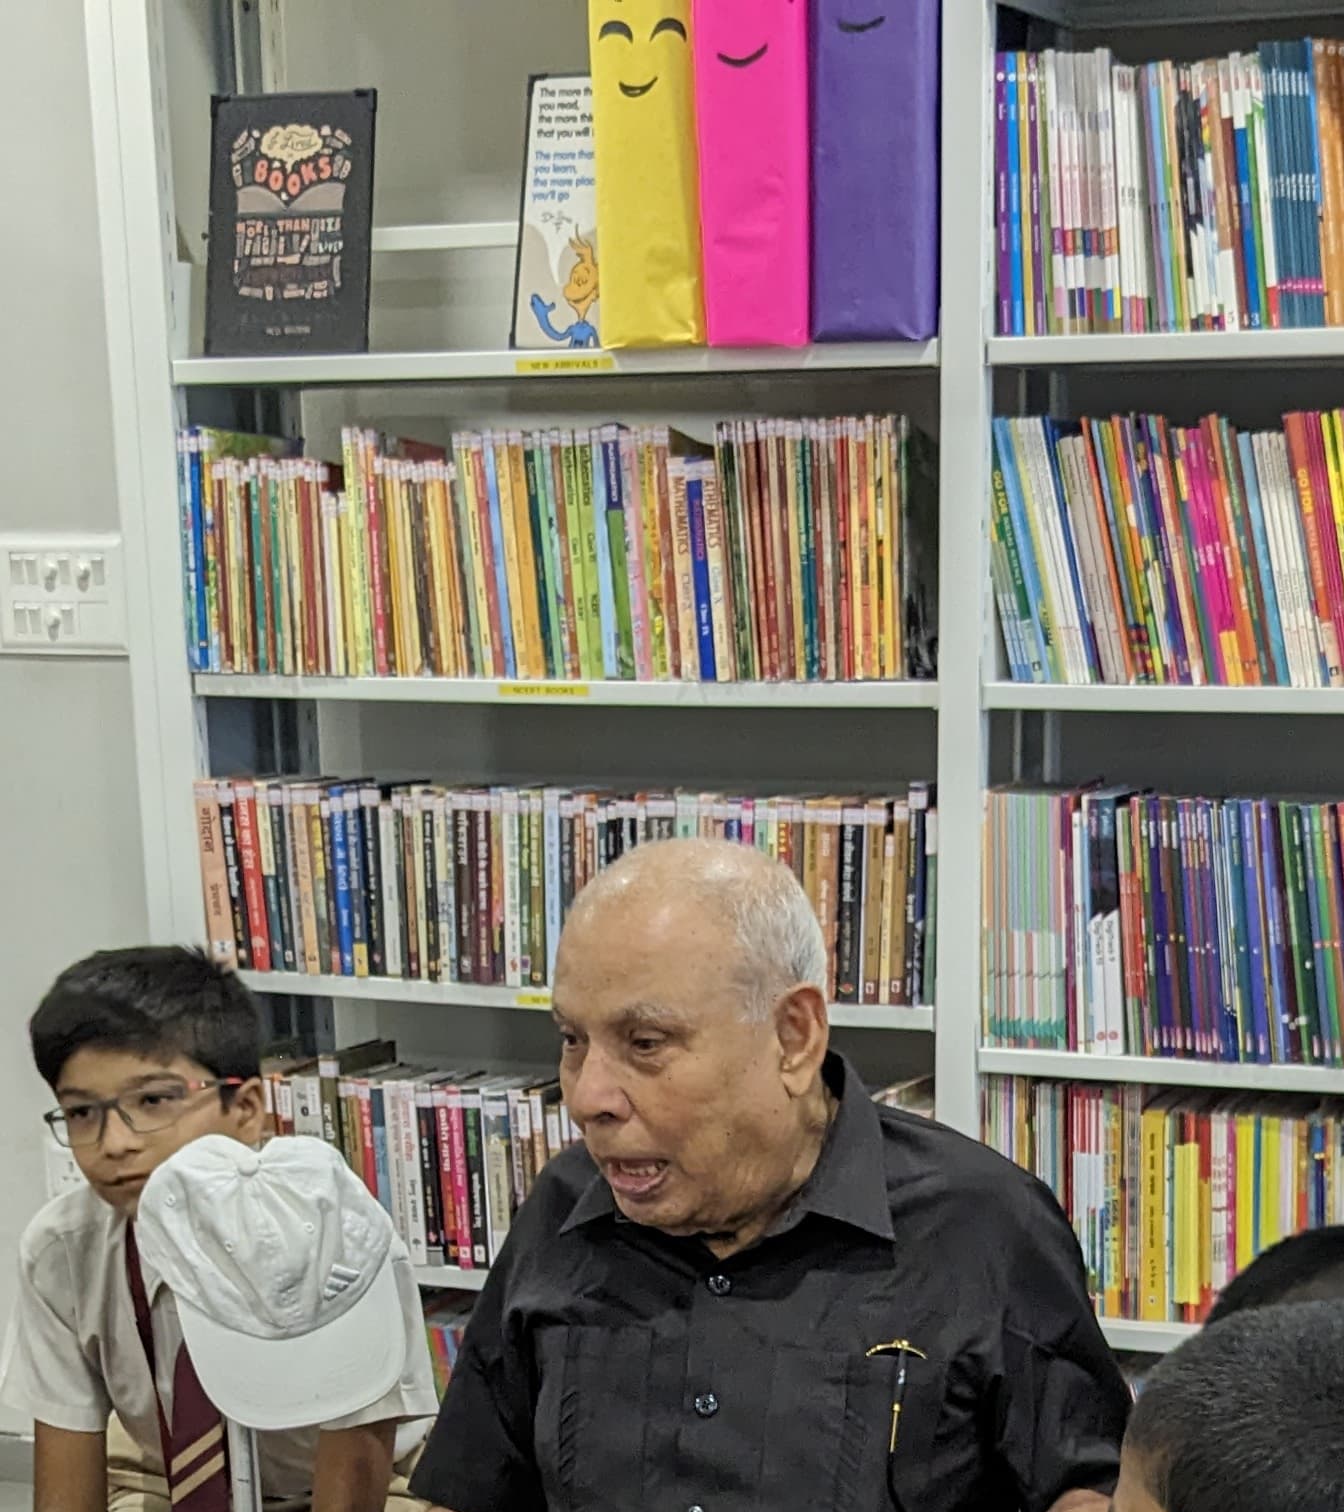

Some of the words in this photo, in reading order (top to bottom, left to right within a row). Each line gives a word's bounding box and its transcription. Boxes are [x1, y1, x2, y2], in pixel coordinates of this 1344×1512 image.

[254, 156, 331, 196] BOOKS
[994, 471, 1004, 490] GO
[1297, 468, 1308, 487] GO
[703, 479, 722, 549] ATHEMATICS
[998, 492, 1009, 515] FOR
[1300, 490, 1312, 514] FOR
[673, 476, 690, 556] MATHEMATICS
